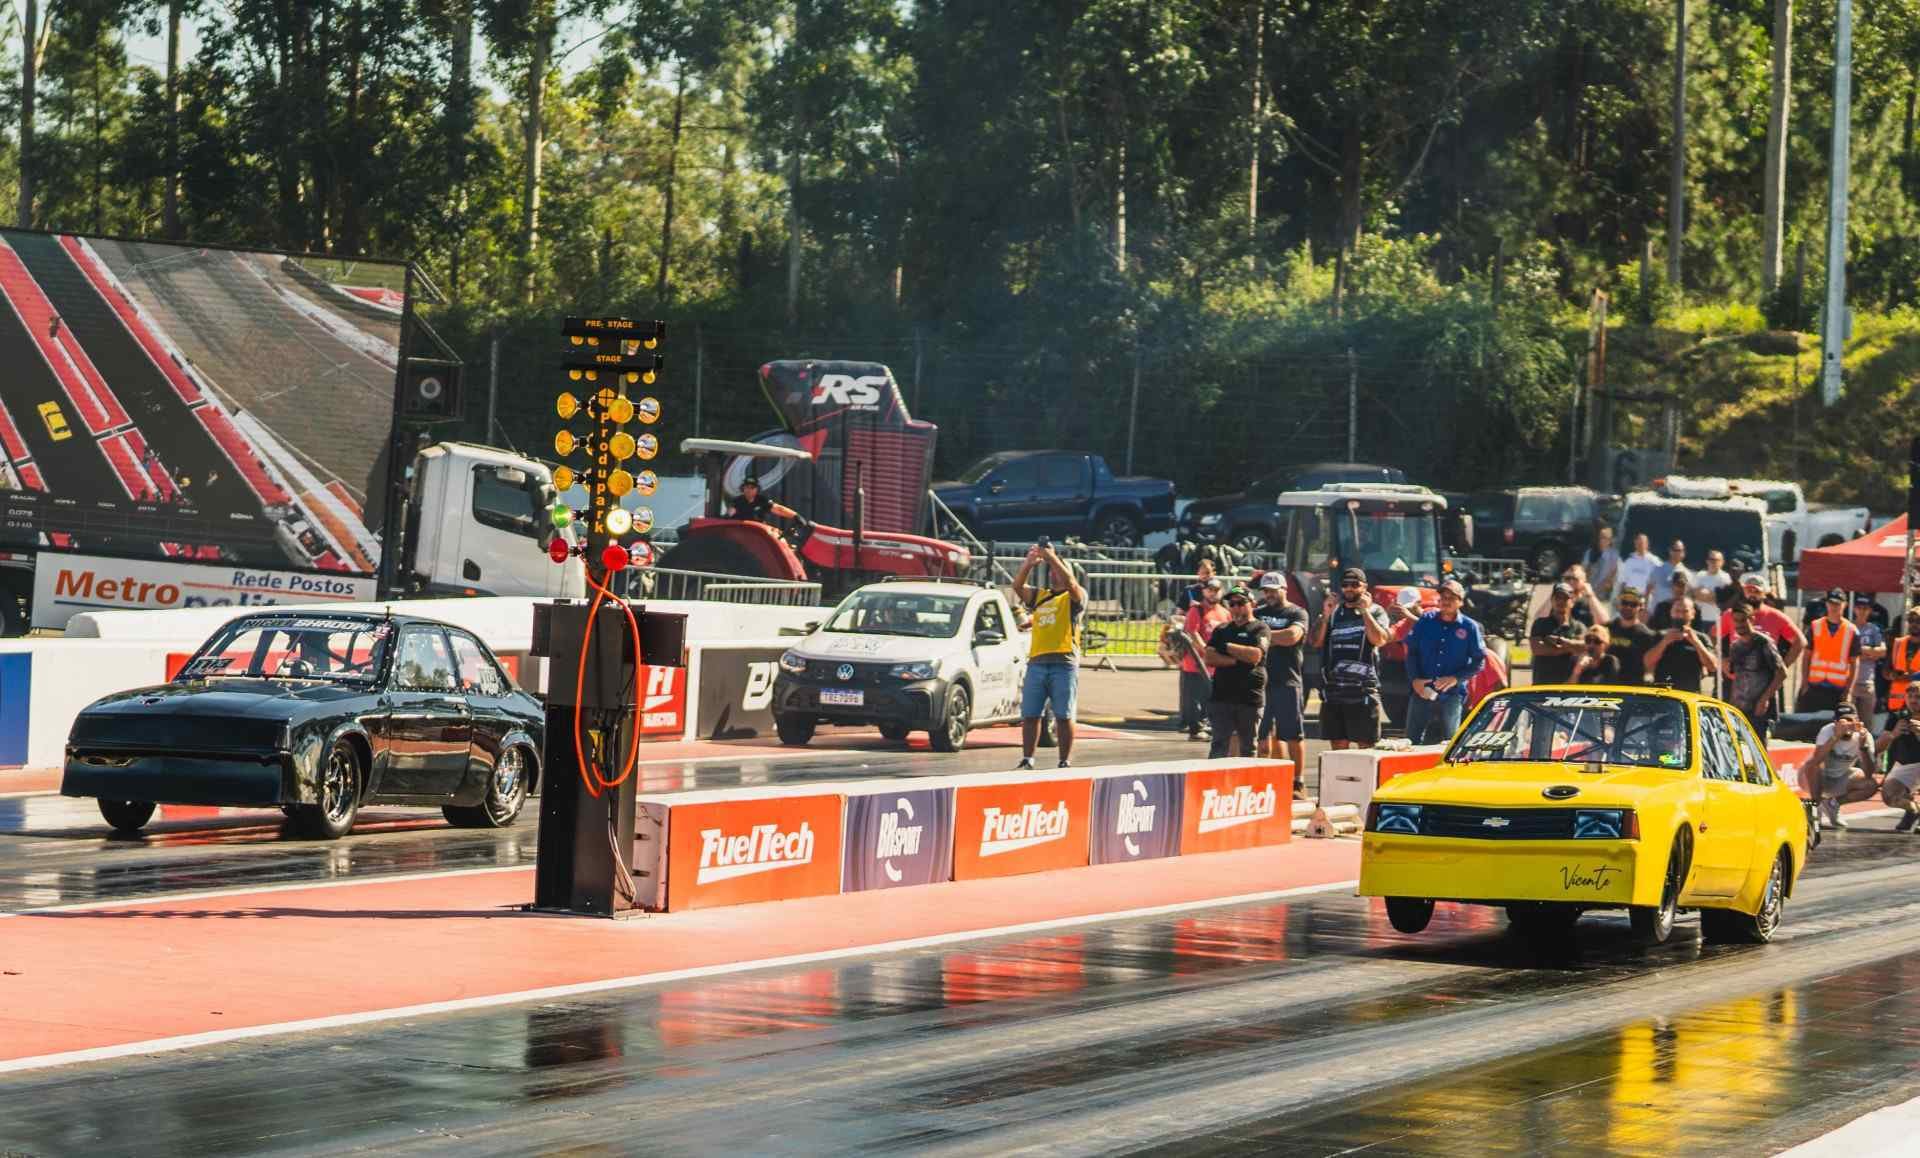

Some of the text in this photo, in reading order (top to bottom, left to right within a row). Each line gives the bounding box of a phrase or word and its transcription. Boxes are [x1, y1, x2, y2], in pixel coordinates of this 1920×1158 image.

[607, 320, 634, 329] STAGE
[596, 354, 623, 363] STAGE
[811, 374, 889, 404] RS
[55, 569, 180, 605] Metro
[232, 571, 355, 595] Rede Postos
[1541, 696, 1624, 711] MDR
[1200, 783, 1277, 820] FuelTech
[983, 800, 1070, 842] FuelTech
[699, 821, 815, 866] FuelTech
[1560, 864, 1622, 890] Vicente
